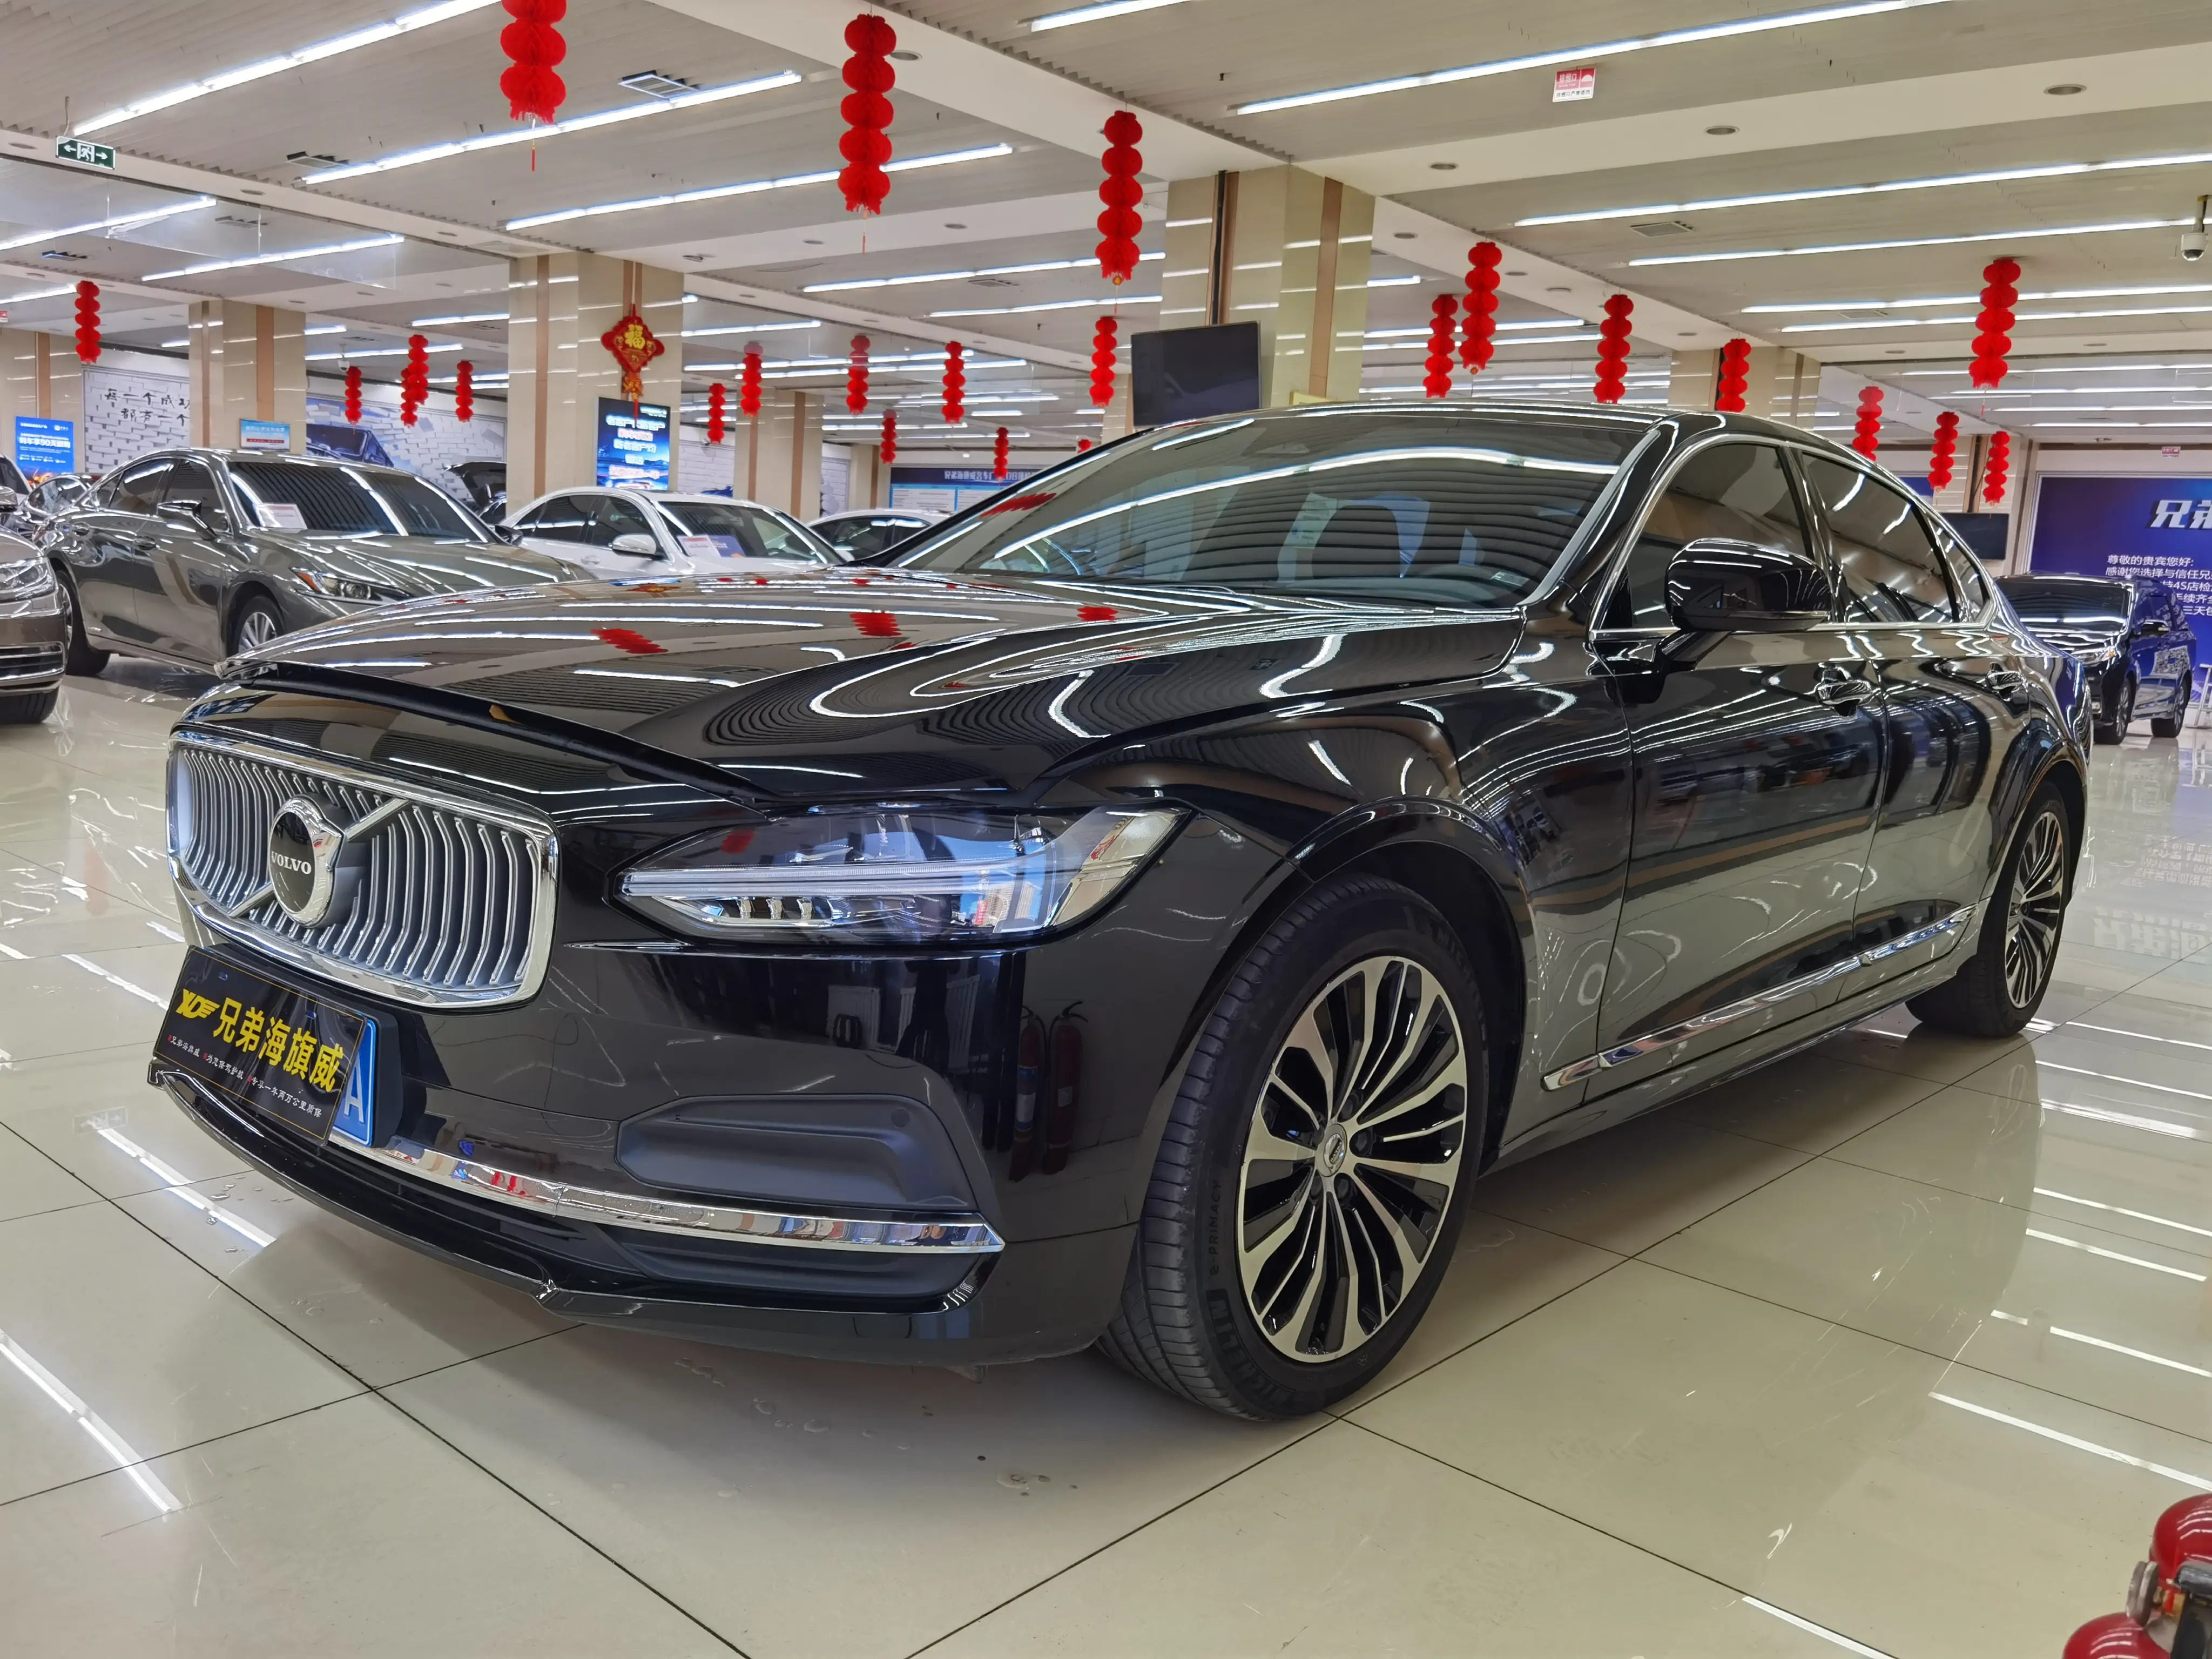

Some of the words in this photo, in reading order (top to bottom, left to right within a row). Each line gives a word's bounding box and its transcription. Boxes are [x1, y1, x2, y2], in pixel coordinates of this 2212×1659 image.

[624, 324, 645, 349] 福
[2106, 567, 2212, 580] 感谢您选择与信任兄
[271, 851, 312, 875] VOLVO
[213, 997, 343, 1092] 兄弟海旗威
[251, 1076, 322, 1118] 专享一年两万公里质保
[344, 1053, 364, 1123] A
[1208, 1180, 1221, 1276] e-PRIMACY
